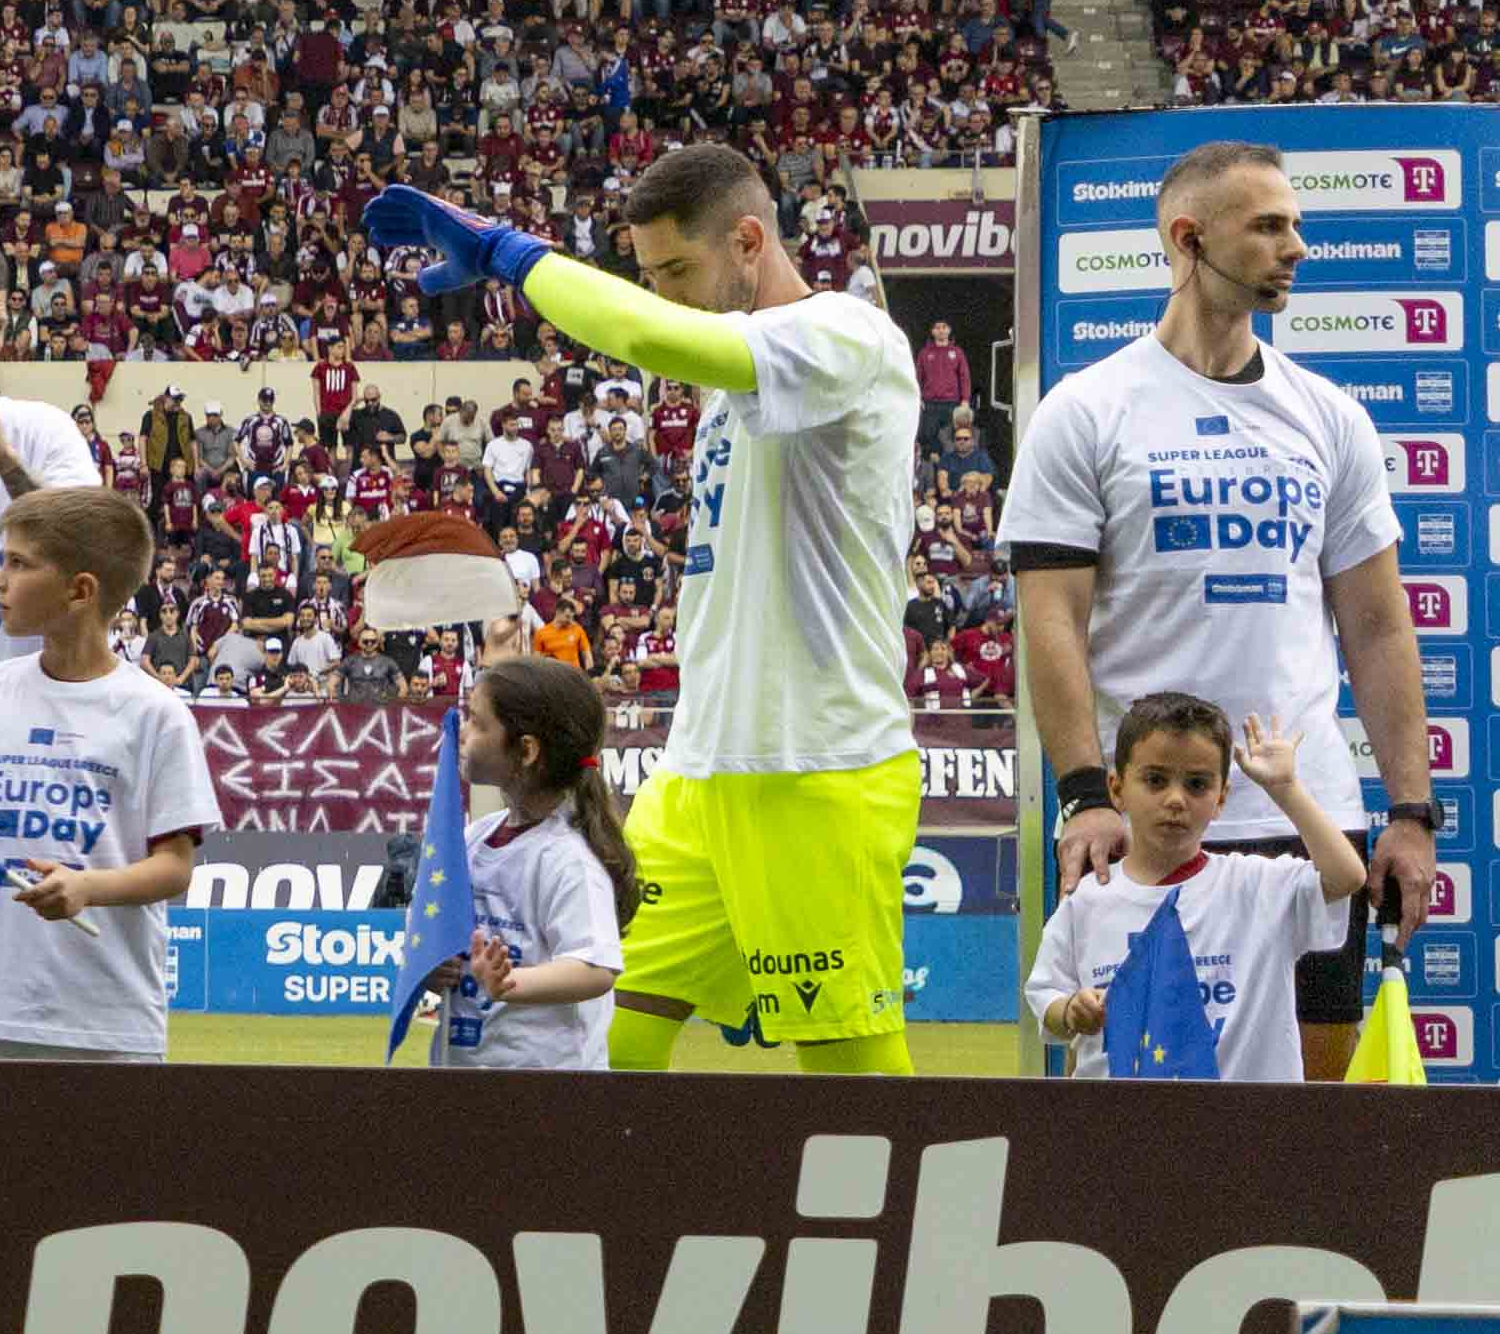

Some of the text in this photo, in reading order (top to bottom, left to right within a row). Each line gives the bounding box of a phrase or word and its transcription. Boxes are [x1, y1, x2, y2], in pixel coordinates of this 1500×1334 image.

[869, 210, 1016, 257] novib
[1148, 446, 1269, 463] SUPER LEAGUE
[1149, 469, 1322, 517] Europe
[1217, 513, 1313, 563] Day
[21, 810, 107, 855] Day
[266, 921, 406, 966] Stoix
[1195, 954, 1233, 966] REECE
[284, 976, 390, 1003] SUPER
